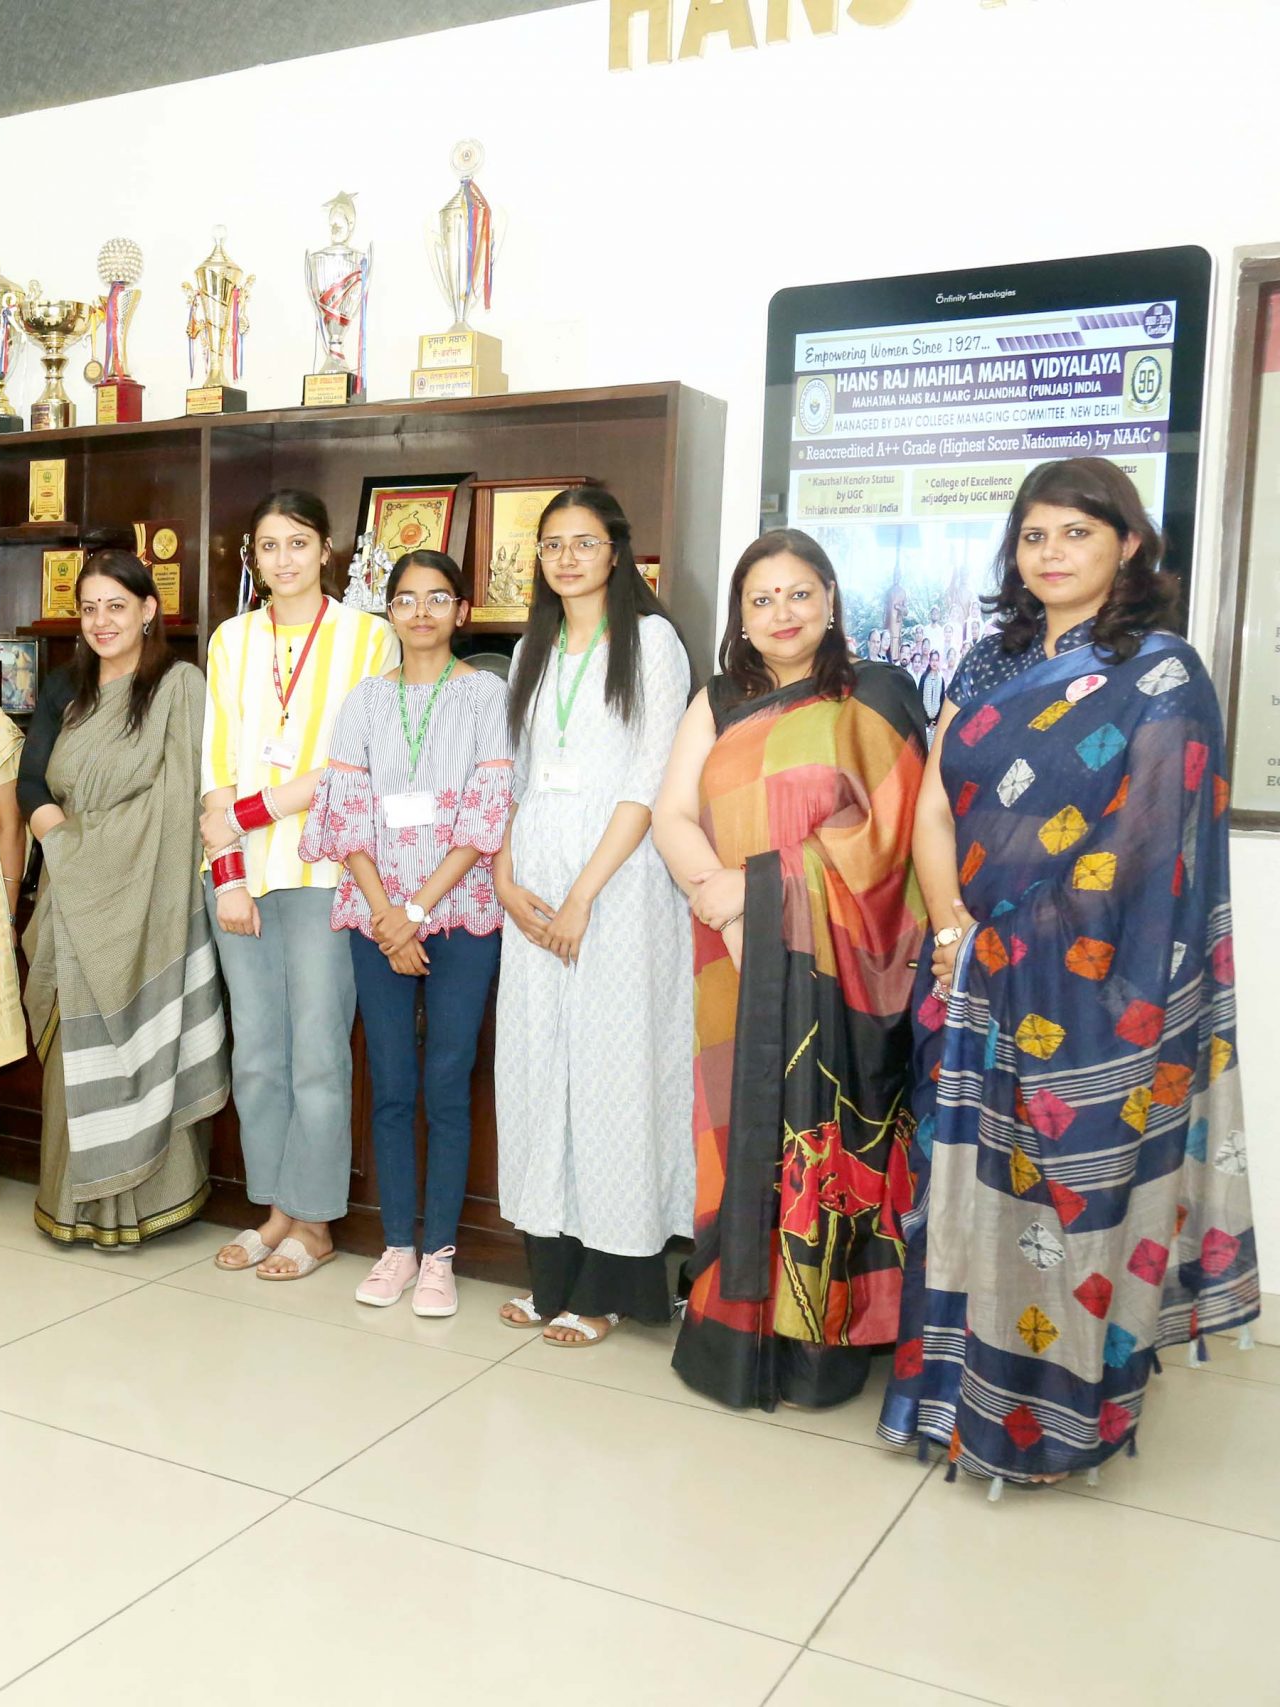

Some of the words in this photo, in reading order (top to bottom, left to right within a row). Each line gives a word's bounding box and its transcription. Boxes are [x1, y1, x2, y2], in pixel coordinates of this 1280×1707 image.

[968, 288, 1017, 301] Technologies
[805, 347, 867, 367] Empowering
[871, 342, 909, 359] Women
[912, 338, 943, 356] Since
[837, 370, 878, 393] HANS
[883, 368, 910, 390] RAJ
[913, 363, 974, 388] MAHILA
[977, 359, 1028, 384] MAHA
[1031, 352, 1122, 380] VIDYALAYA
[1138, 369, 1155, 394] 96
[852, 394, 897, 409] MAHATMA
[899, 392, 923, 405] HANS
[924, 391, 941, 404] RAJ
[942, 389, 971, 403] MARG
[973, 386, 1028, 401] JALANDHAR
[1029, 382, 1073, 400] (PUNJAB)
[1075, 380, 1102, 394] INDIA
[835, 418, 879, 433] MANAGED
[881, 417, 892, 429] BY
[894, 416, 913, 429] DAV
[916, 413, 955, 428] COLLEGE
[957, 411, 1010, 425] MANAGING
[1071, 407, 1091, 418] NEW
[1094, 403, 1120, 417] DELHI
[806, 443, 874, 461] Reaccredited
[876, 441, 900, 457] A++
[902, 440, 936, 456] Grade
[939, 436, 986, 458] (Highest
[988, 435, 1019, 451] Score
[1021, 430, 1092, 449] Nationwide)
[1095, 429, 1112, 450] by
[1113, 426, 1151, 445] NAAC
[812, 476, 842, 487] Kaushal
[843, 475, 870, 486] Kendra
[871, 474, 895, 484] Status
[930, 478, 959, 490] College
[960, 477, 969, 487] of
[970, 475, 1012, 487] Excellence
[836, 490, 846, 502] by
[847, 490, 864, 500] UGC
[921, 493, 957, 505] adjudged
[958, 492, 968, 504] by
[970, 491, 988, 501] UGC
[990, 490, 1015, 501] MHRD
[805, 505, 838, 515] Initiative
[838, 504, 861, 514] under
[862, 502, 878, 513] Skill
[879, 503, 899, 513] India
